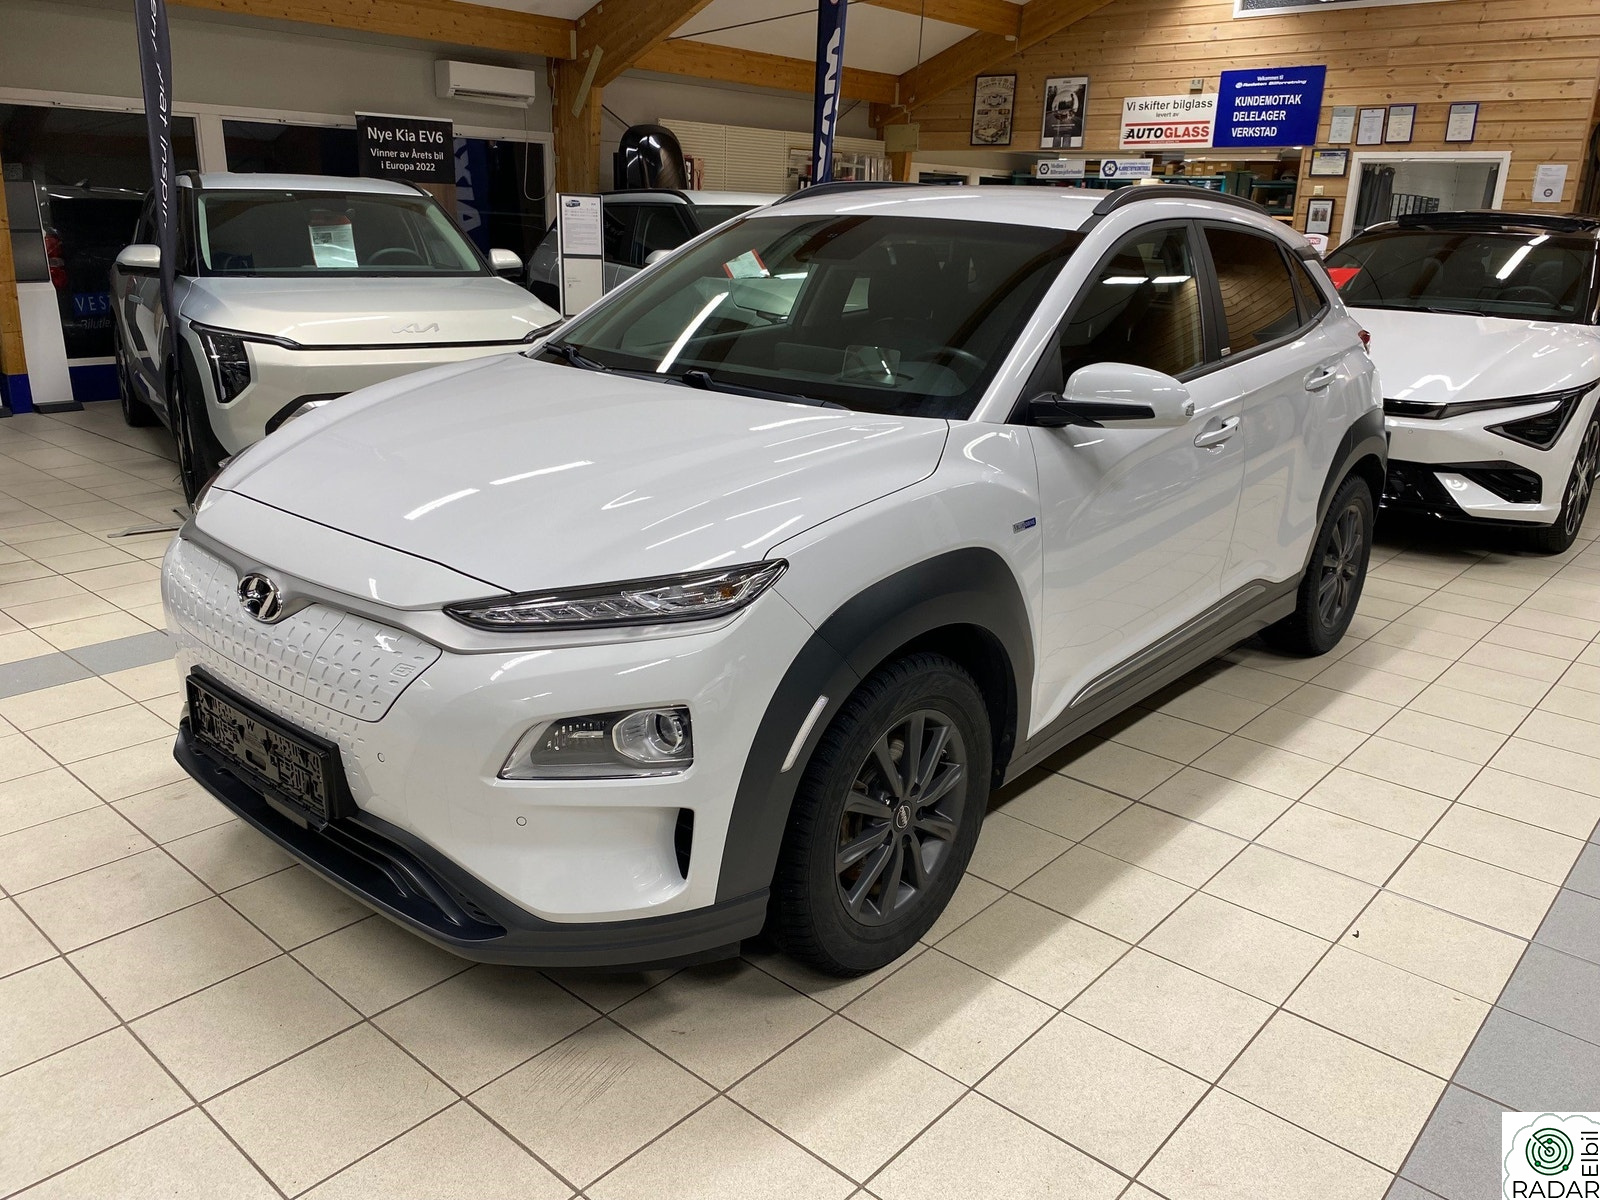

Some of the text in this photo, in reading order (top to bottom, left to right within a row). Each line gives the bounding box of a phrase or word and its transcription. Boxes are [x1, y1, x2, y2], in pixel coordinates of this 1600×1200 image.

[1126, 98, 1213, 111] Vi skifter bilglass
[1235, 94, 1302, 107] KUNDEMOTTAK
[1233, 110, 1286, 122] DELELAGER
[367, 126, 444, 144] Nye Kia EV6
[1125, 126, 1209, 140] AUTOGLASS
[1231, 127, 1278, 138] VERKSTAD
[370, 147, 444, 160] Vinner av Årets bil
[380, 160, 436, 172] i Europa 2022
